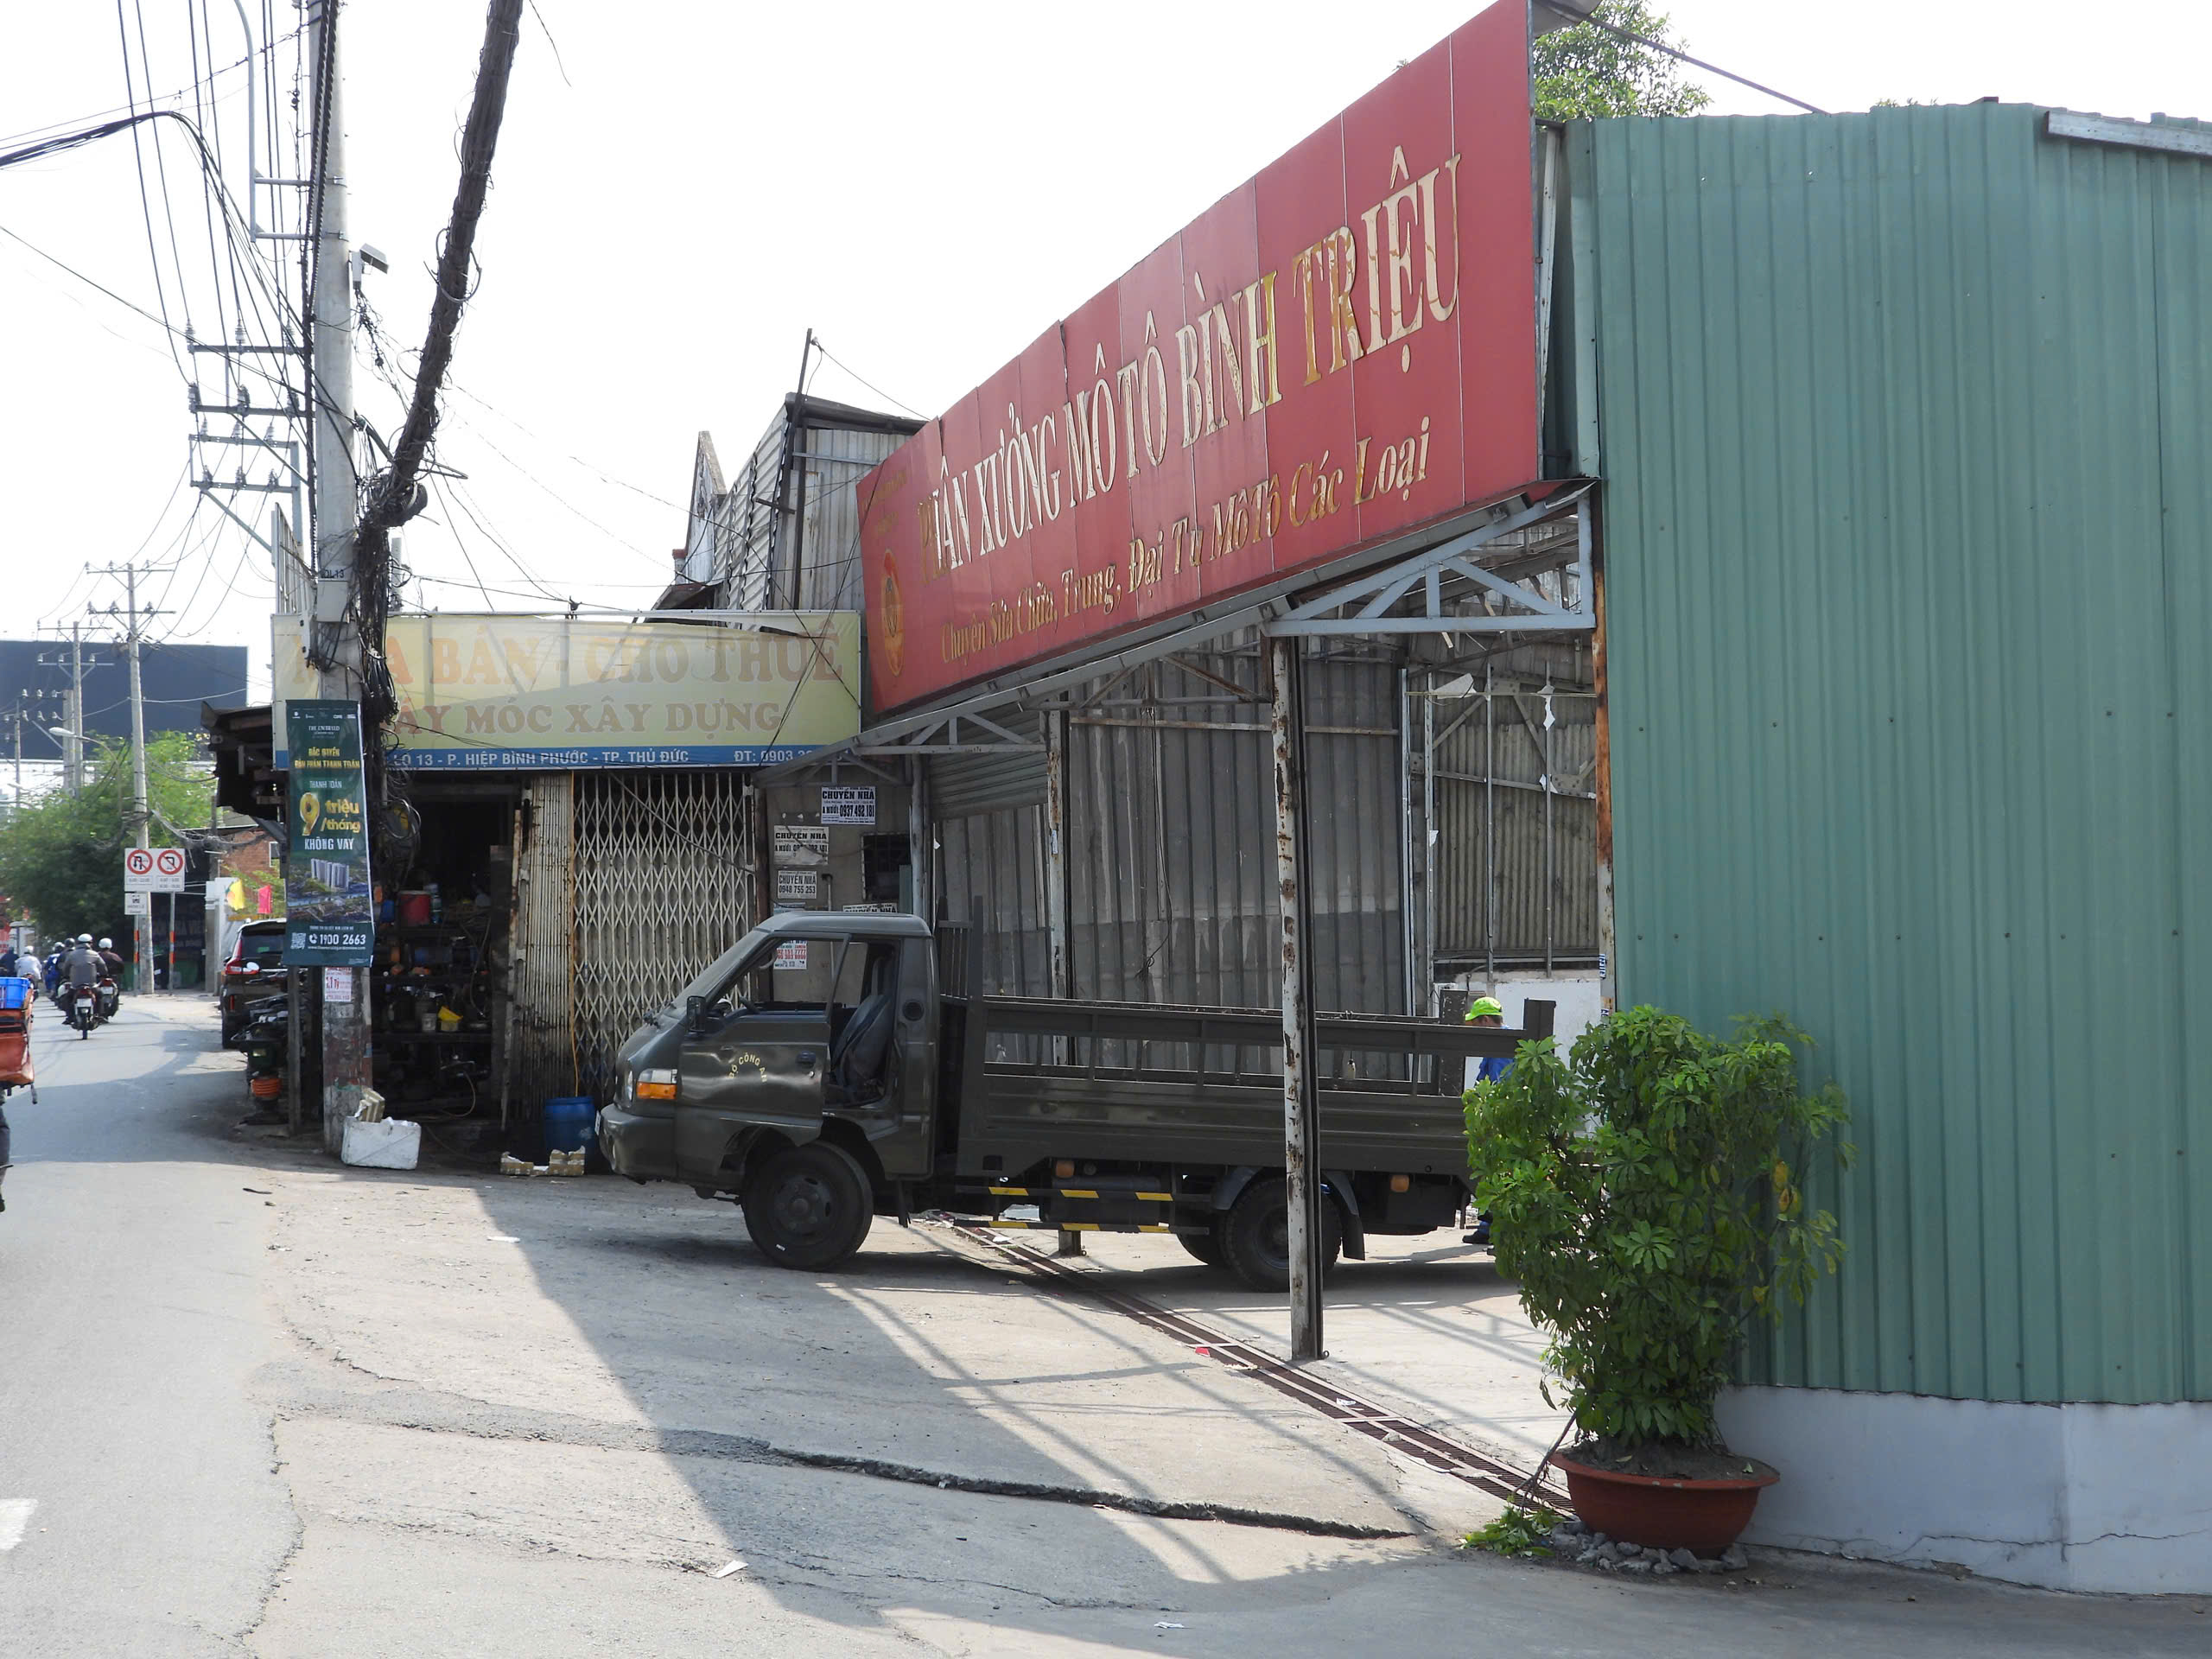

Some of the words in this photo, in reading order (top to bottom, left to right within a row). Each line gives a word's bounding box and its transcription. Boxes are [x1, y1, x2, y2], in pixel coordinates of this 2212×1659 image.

[918, 454, 973, 584] PHÂN
[974, 402, 1061, 556] XƯỞNG
[1175, 270, 1283, 448] BÌNH
[1293, 144, 1461, 387] TRIỆU
[941, 612, 987, 665] Chuyên
[1061, 563, 1122, 619] Trung,
[1128, 530, 1164, 598] Đại
[1289, 449, 1344, 527] Các
[1352, 416, 1431, 505] Loại
[585, 635, 690, 683] CHO
[707, 620, 843, 683] THUÊ
[565, 696, 653, 733] XÂY
[665, 697, 782, 740] DỰNG
[416, 753, 433, 766] 13
[448, 753, 461, 766] P.
[466, 750, 498, 766] HIỆP
[503, 750, 535, 764] BÌNH
[540, 749, 588, 764] PHƯỚC
[601, 751, 623, 762] TP.
[628, 747, 655, 762] THỦ
[659, 748, 689, 762] ĐỨC
[734, 750, 755, 762] ĐT:
[760, 750, 793, 762] 0903
[300, 792, 320, 836] 9
[325, 798, 359, 817] triệu
[839, 804, 874, 817] 0937.492.181
[321, 817, 361, 834] /tháng
[305, 836, 334, 850] KHÔNG
[337, 838, 354, 849] VAY
[779, 885, 792, 893] 0948
[320, 933, 340, 945] 1900
[342, 934, 366, 945] 2663
[739, 1052, 760, 1066] CÔNG
